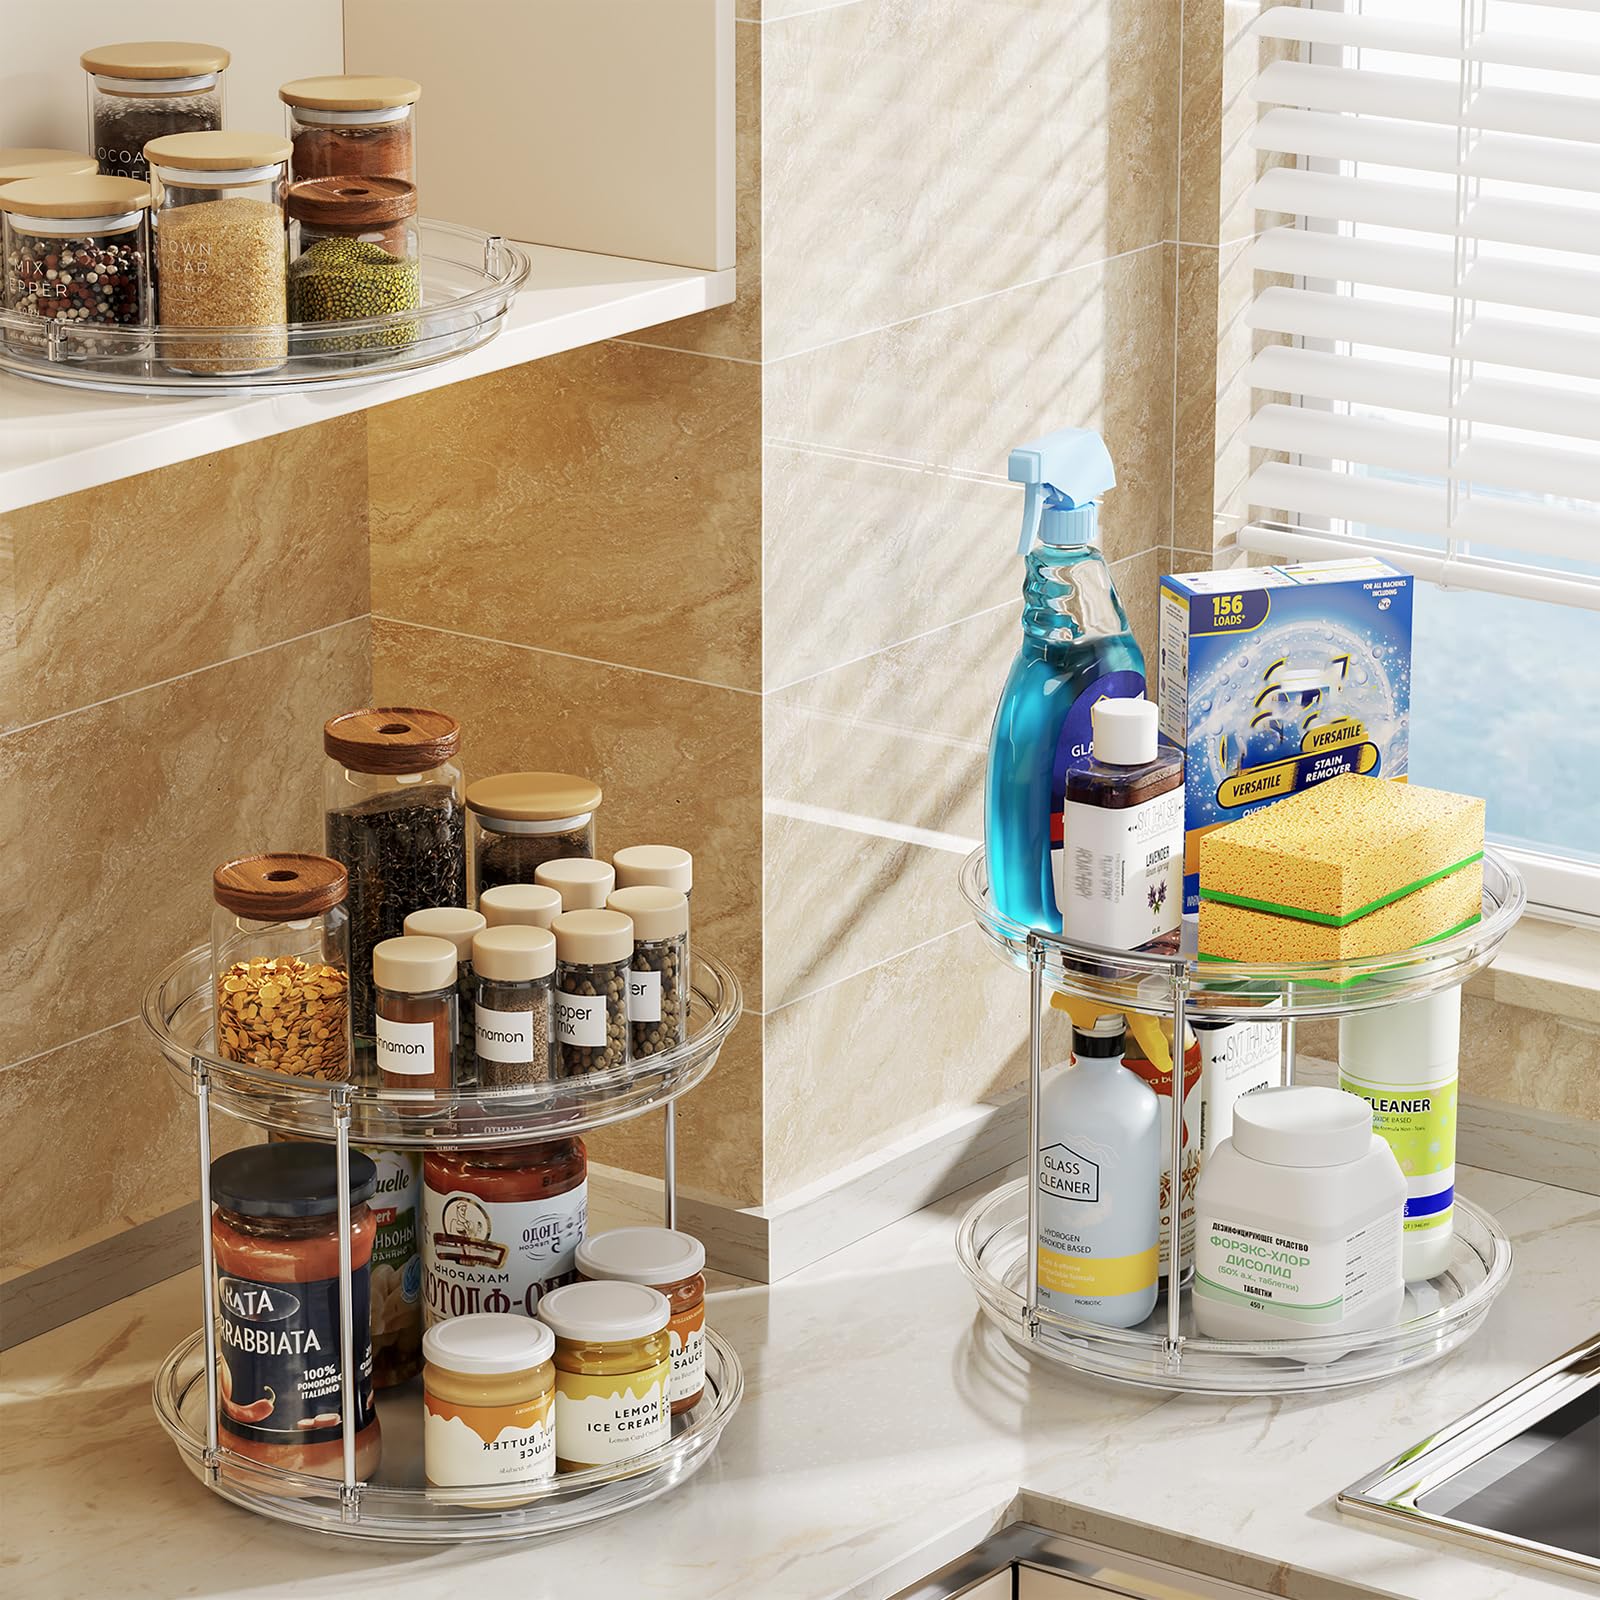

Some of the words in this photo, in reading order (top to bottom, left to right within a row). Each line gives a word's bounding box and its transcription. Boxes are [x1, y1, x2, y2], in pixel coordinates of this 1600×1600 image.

[14, 259, 43, 276] MIX
[1212, 594, 1244, 616] 156
[1313, 724, 1362, 747] VERSATILE
[1305, 763, 1351, 783] REMOVER
[1314, 755, 1343, 771] STAIN
[1232, 774, 1281, 798] VERSATILE
[1145, 845, 1170, 868] LAVENDER
[478, 1026, 524, 1043] nnamon
[1044, 1155, 1080, 1175] GLASS
[1040, 1172, 1090, 1194] CLEANER
[1044, 1227, 1081, 1242] HYDROGEN
[1212, 1222, 1273, 1244] ДЕЗИНФИЦИРУЮЩЕЕ
[1275, 1238, 1309, 1252] СРЕДСТВО
[1067, 1243, 1092, 1254] BASED
[1210, 1236, 1310, 1267] ФОРЭКС-ХЛОР
[1226, 1254, 1292, 1279] ДИСОЛИД
[1218, 1266, 1239, 1277] (50%
[1259, 1276, 1299, 1293] таблетки)
[1243, 1284, 1273, 1298] ТАБЛЕТКИ
[1250, 1301, 1261, 1309] 450
[674, 1348, 703, 1370] SAUCE
[303, 1363, 337, 1381] 100%
[301, 1384, 340, 1400] ITALIANO
[615, 1401, 658, 1419] LEMON
[587, 1423, 611, 1432] ICE
[617, 1414, 659, 1431] CREAM
